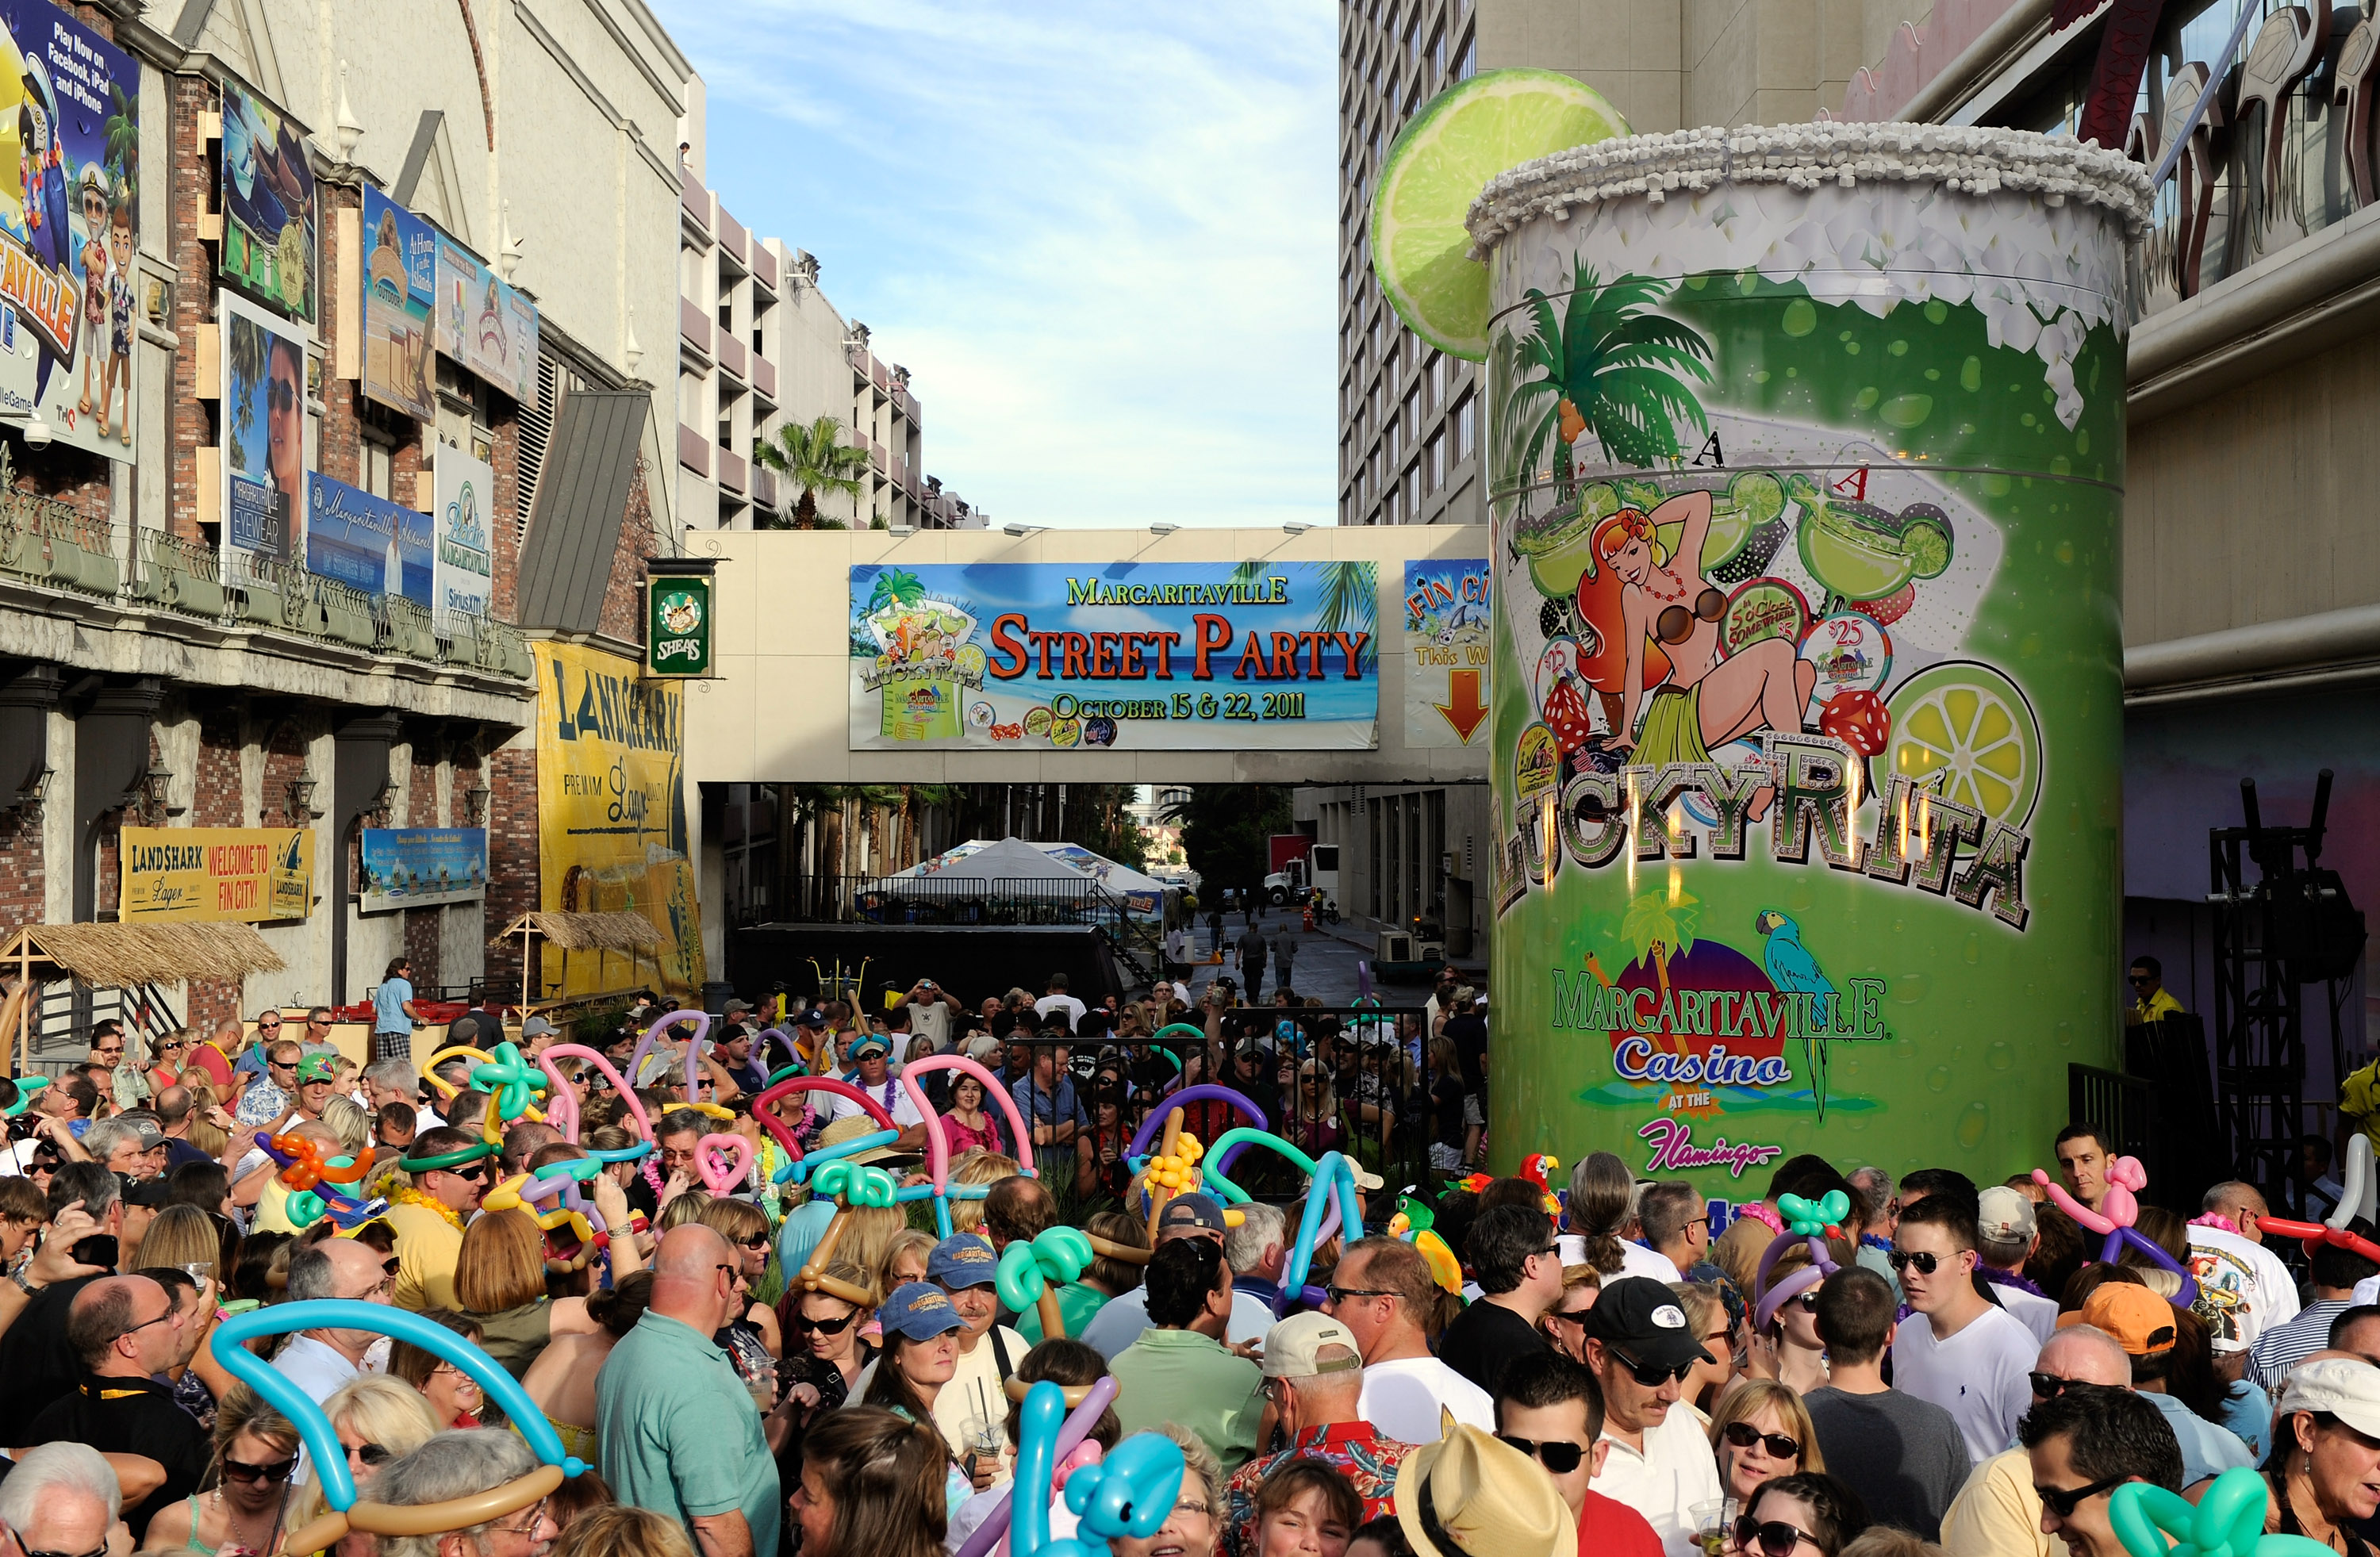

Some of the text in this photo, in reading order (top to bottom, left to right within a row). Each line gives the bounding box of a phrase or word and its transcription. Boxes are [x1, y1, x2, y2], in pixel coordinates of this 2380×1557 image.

[54, 21, 104, 70] Play Now on
[48, 42, 109, 96] Facebook, iPad
[56, 75, 102, 114] and iPhone
[409, 232, 434, 255] At Home
[411, 255, 432, 293] Islands
[0, 243, 76, 352] AVILLE
[378, 285, 401, 309] OUTDOOR
[56, 404, 75, 431] THQ
[1691, 431, 1725, 468] A
[1833, 464, 1869, 501] A
[234, 508, 278, 545] EYEWEAR
[325, 488, 392, 540] Margaritaville
[398, 515, 432, 554] Apparel
[447, 501, 486, 552] Radio
[439, 533, 490, 577] MARGARITAVILLE
[1066, 576, 1288, 606] MARGARITAVILLE
[1407, 577, 1454, 619] FIN
[1728, 608, 1796, 651] SOMEWHERE
[1729, 608, 1742, 631] 5
[1778, 622, 1794, 642] $5
[1829, 619, 1864, 646] $25
[658, 639, 700, 661] SHEAS
[989, 612, 1370, 681] STREET PARTY
[1415, 646, 1457, 665] This
[1544, 642, 1567, 674] $25
[1814, 658, 1873, 673] MARGARITAVILLE
[553, 659, 680, 754] LANDSHARK
[895, 692, 949, 704] MARGARITAVILLE
[1051, 692, 1305, 721] OCTOBER 15 & 22, 2011
[132, 844, 268, 876] LANDSHARK WELCOME TO
[152, 876, 182, 911] Lager
[218, 880, 258, 911] FIN CITY!
[276, 880, 303, 897] LANDSHARK
[1553, 968, 1886, 1040] MARGARITAVILLE
[1614, 1036, 1791, 1085] Casino
[1669, 1092, 1710, 1110] AT THE
[1638, 1118, 1782, 1178] Flamingo
